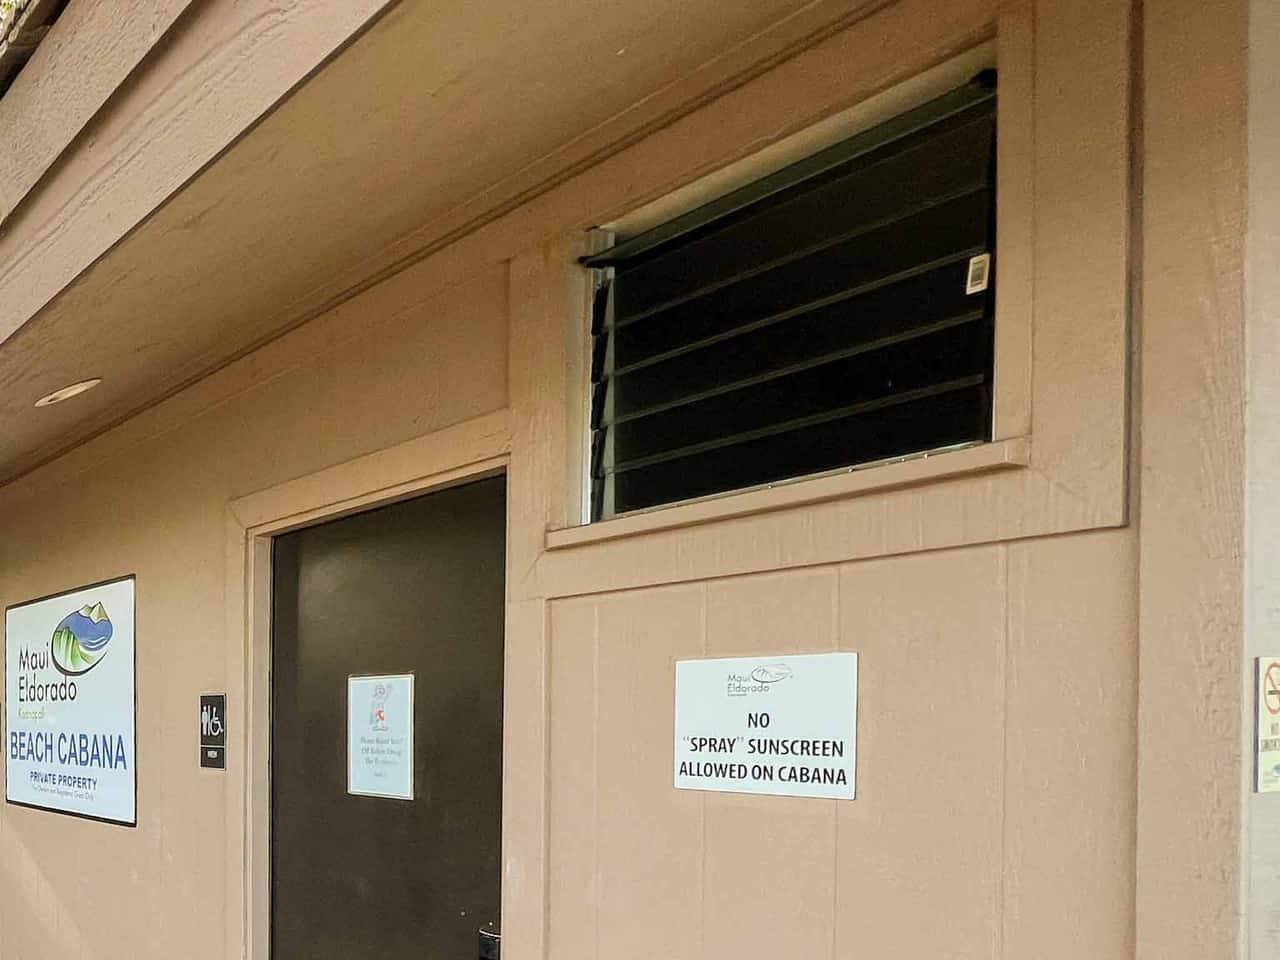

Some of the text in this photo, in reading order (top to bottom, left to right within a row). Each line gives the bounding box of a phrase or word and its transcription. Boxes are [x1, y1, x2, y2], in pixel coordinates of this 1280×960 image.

[19, 642, 49, 671] Maui
[728, 674, 751, 682] Maui
[728, 682, 770, 692] Eldorado
[18, 675, 77, 702] Eldorado
[748, 712, 770, 728] NO
[10, 731, 127, 769] BEACH CABANA
[747, 738, 844, 757] SUNSCREEN
[30, 771, 98, 790] PRIVATE PROPERTY
[679, 761, 847, 785] ALLOWED ON CABANA
